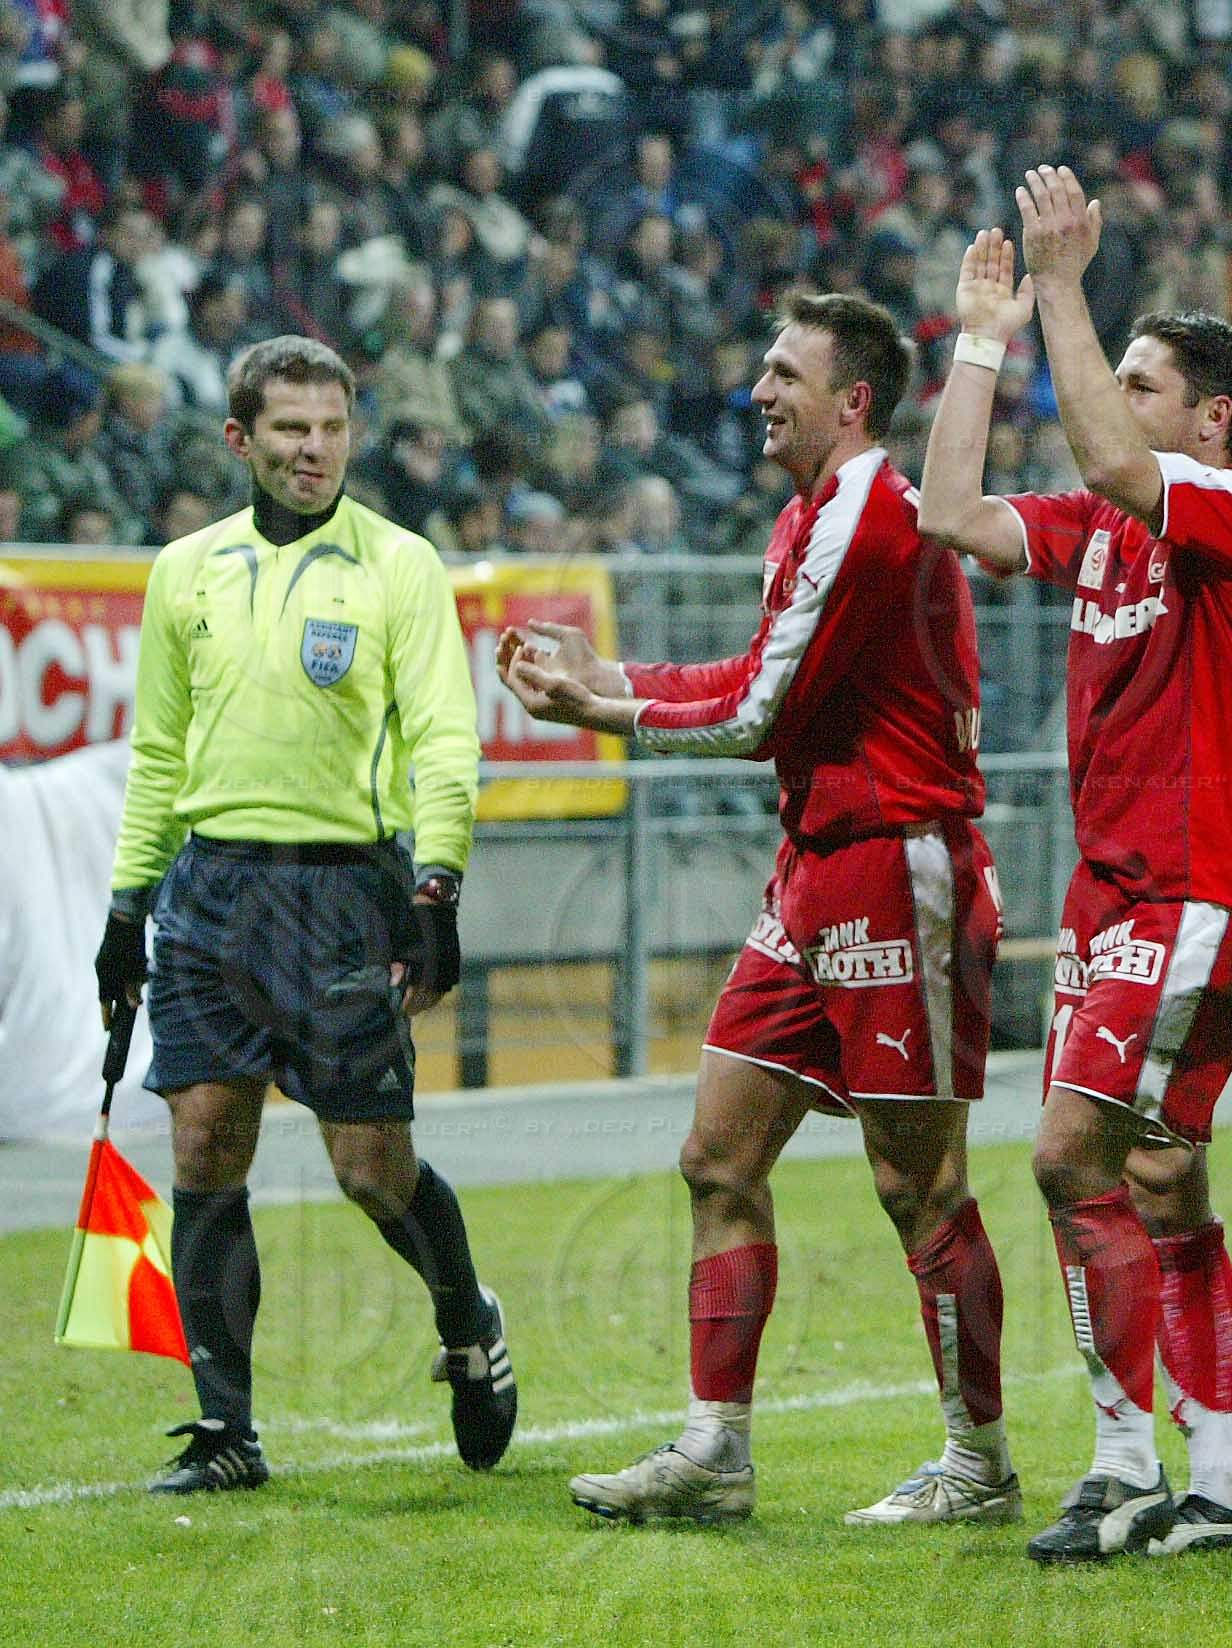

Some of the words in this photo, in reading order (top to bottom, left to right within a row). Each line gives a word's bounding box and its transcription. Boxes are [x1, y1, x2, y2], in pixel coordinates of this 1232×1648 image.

[311, 659, 338, 673] FIFA
[820, 916, 870, 952] TANK
[817, 948, 904, 980] ROTH
